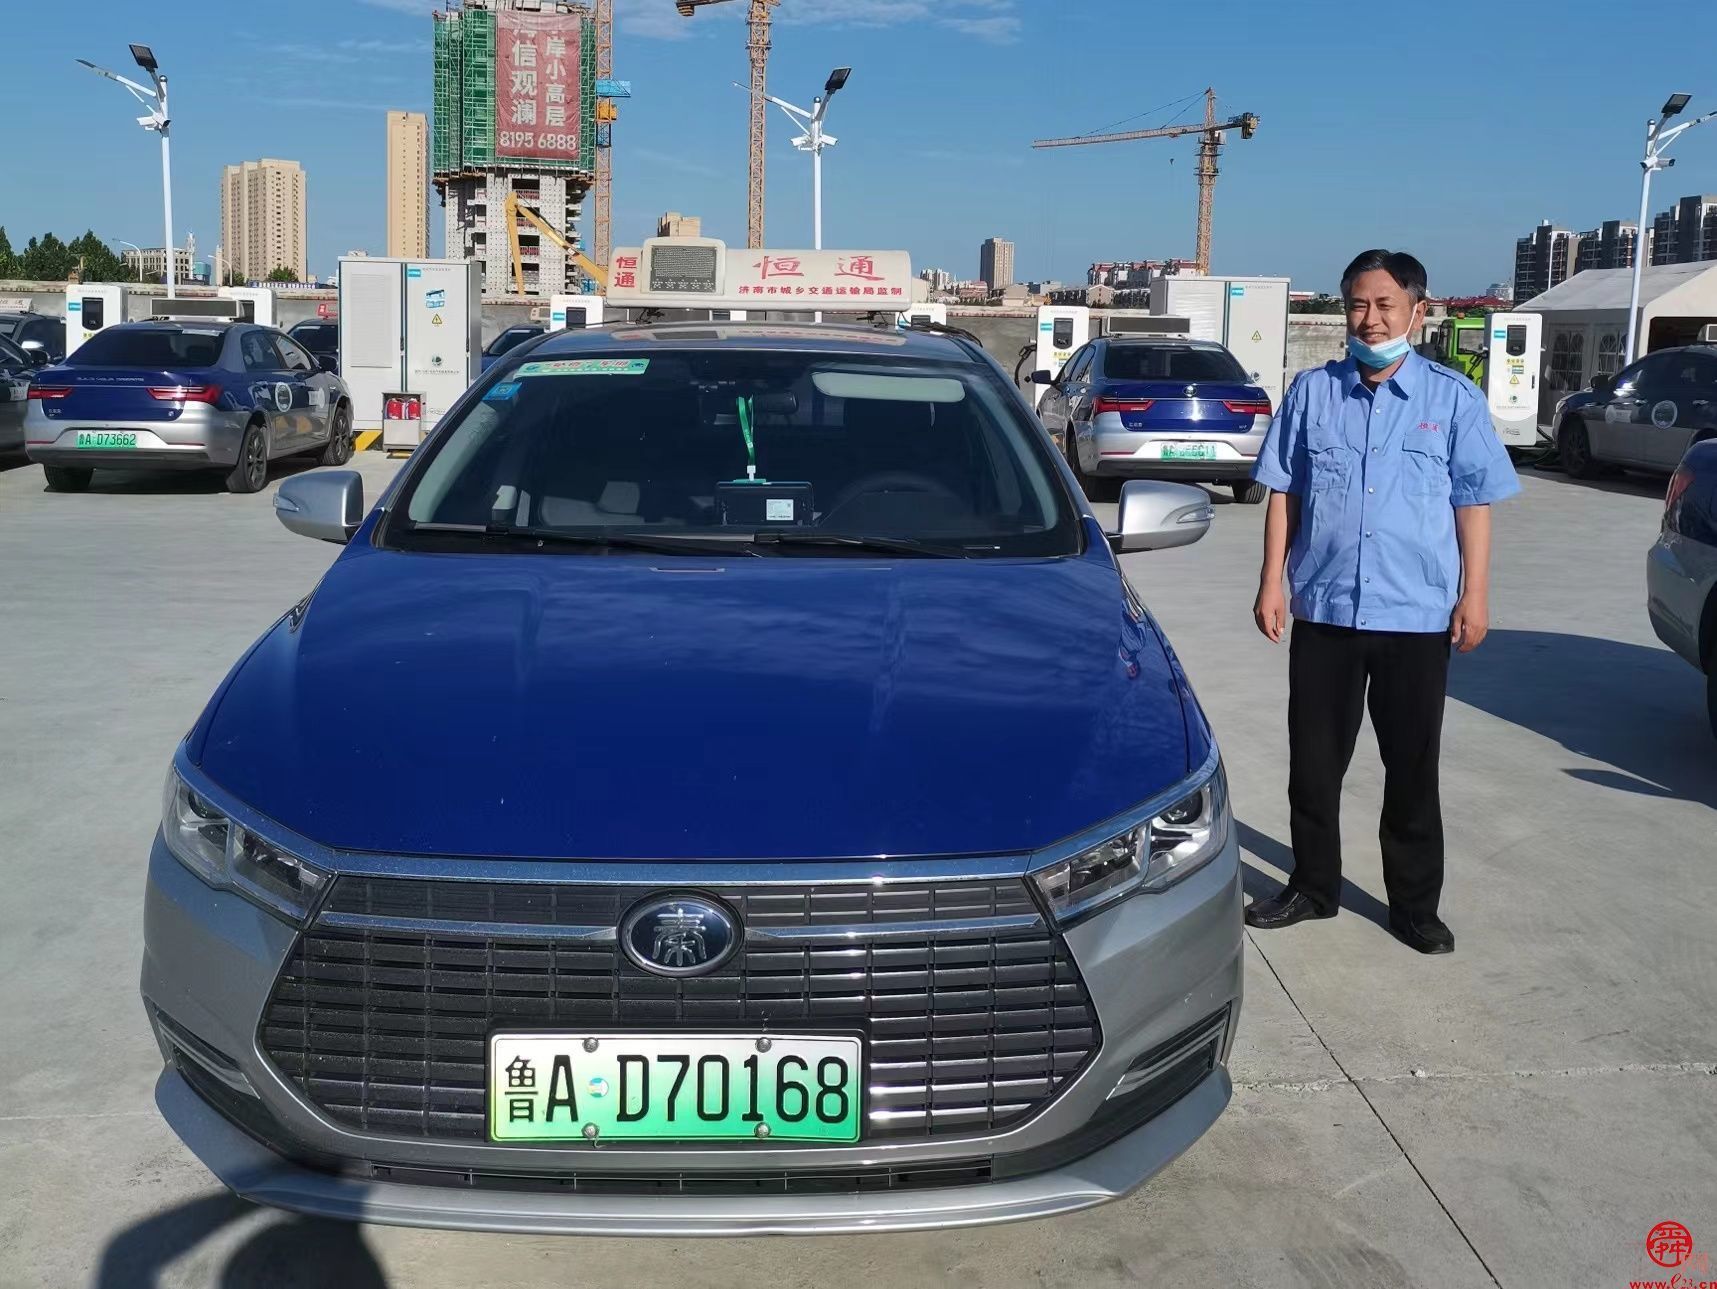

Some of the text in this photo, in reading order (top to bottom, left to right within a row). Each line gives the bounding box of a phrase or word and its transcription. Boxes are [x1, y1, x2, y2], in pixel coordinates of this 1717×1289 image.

[511, 30, 537, 126] 信观澜
[545, 31, 567, 127] 岸小高层
[499, 131, 577, 150] 8195 6888
[614, 255, 638, 288] 恒通
[752, 255, 885, 281] 恒通
[738, 285, 903, 296] 济南市城乡交通运输局监制
[96, 433, 137, 446] D73662
[504, 1053, 850, 1124] 鲁A D70168
